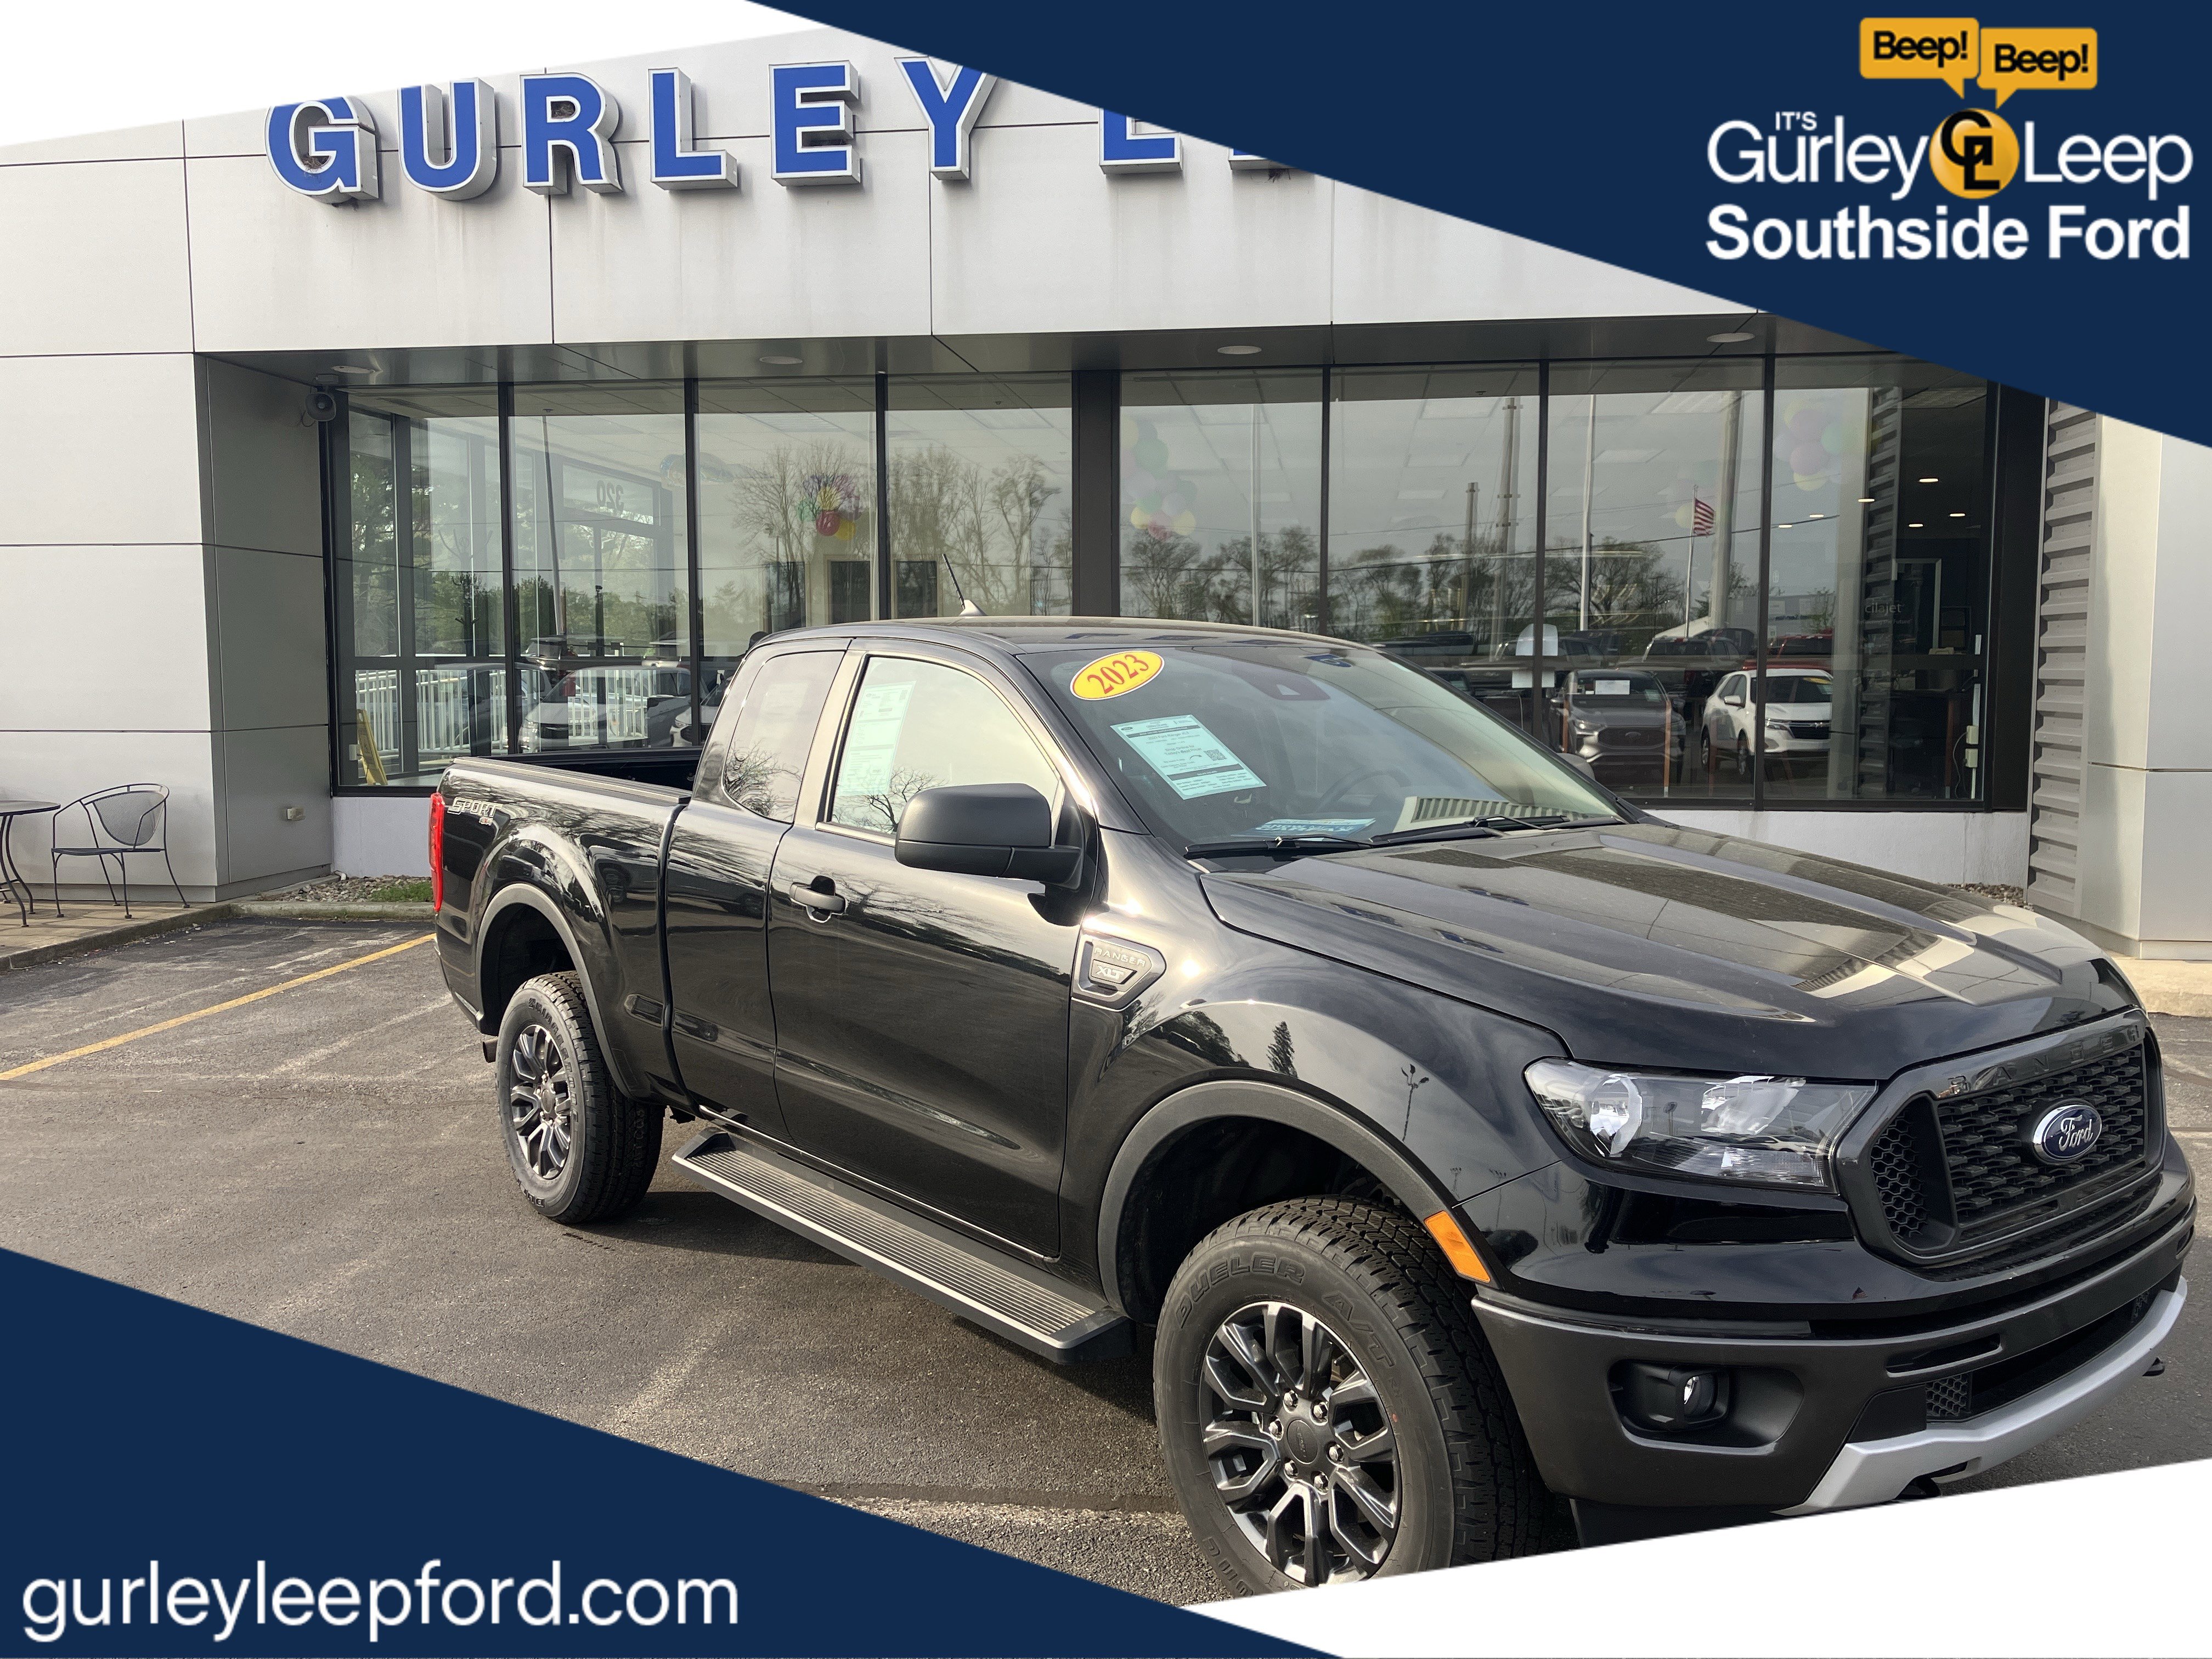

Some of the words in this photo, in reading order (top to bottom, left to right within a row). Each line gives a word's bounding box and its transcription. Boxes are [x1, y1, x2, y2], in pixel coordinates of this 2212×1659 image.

[266, 57, 997, 203] GURLEY
[1087, 654, 1149, 695] 2023
[447, 797, 503, 817] SPORT
[1094, 947, 1146, 967] RANGER
[1096, 965, 1124, 980] XLT
[2058, 1114, 2094, 1152] Ford
[1176, 1252, 1306, 1330] DUELER
